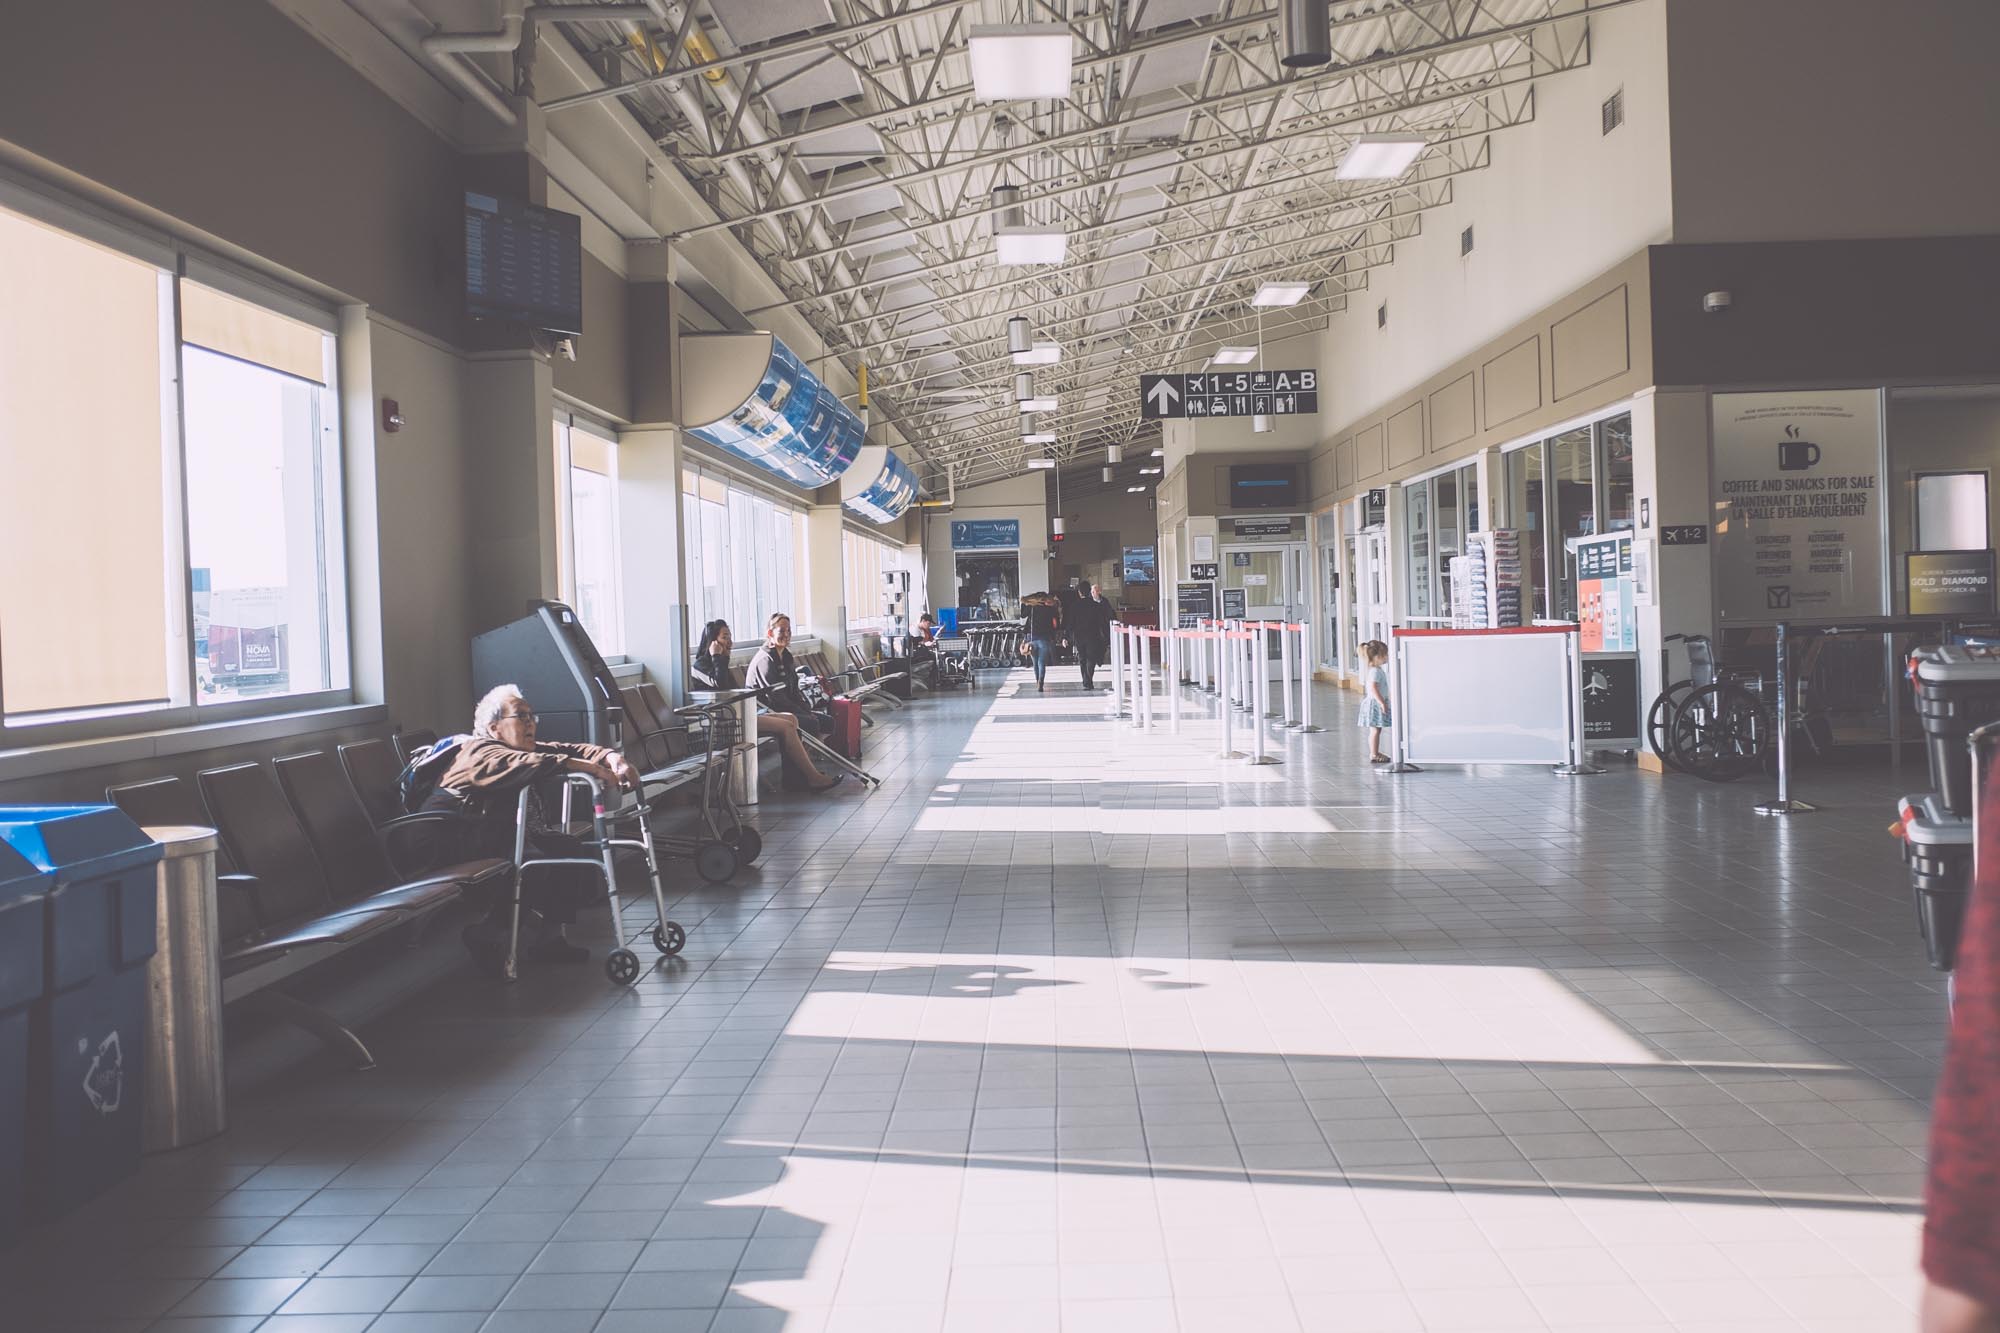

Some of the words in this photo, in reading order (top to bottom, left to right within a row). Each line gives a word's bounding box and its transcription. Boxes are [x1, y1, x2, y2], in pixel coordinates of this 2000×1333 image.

[1210, 375, 1248, 393] 1-5
[1275, 372, 1316, 391] A-B
[1722, 479, 1760, 493] COFFEE
[1761, 479, 1782, 492] AND
[1784, 477, 1825, 492] SNACKS
[1828, 476, 1847, 490] FOR
[1850, 475, 1875, 489] SALE
[1732, 494, 1790, 508] MAINTENANT
[1794, 493, 1807, 506] EN
[1809, 492, 1838, 506] VENTE
[1840, 491, 1867, 505] DANS
[1733, 507, 1745, 520] LA
[1747, 506, 1774, 520] SALLE
[1777, 504, 1865, 519] D'EMBARQUEMENT
[993, 523, 1017, 532] North
[1684, 527, 1701, 539] 1-2
[1911, 577, 1936, 586] GOLD
[1941, 576, 1988, 585] DIAMOND
[246, 645, 271, 655] NOVA
